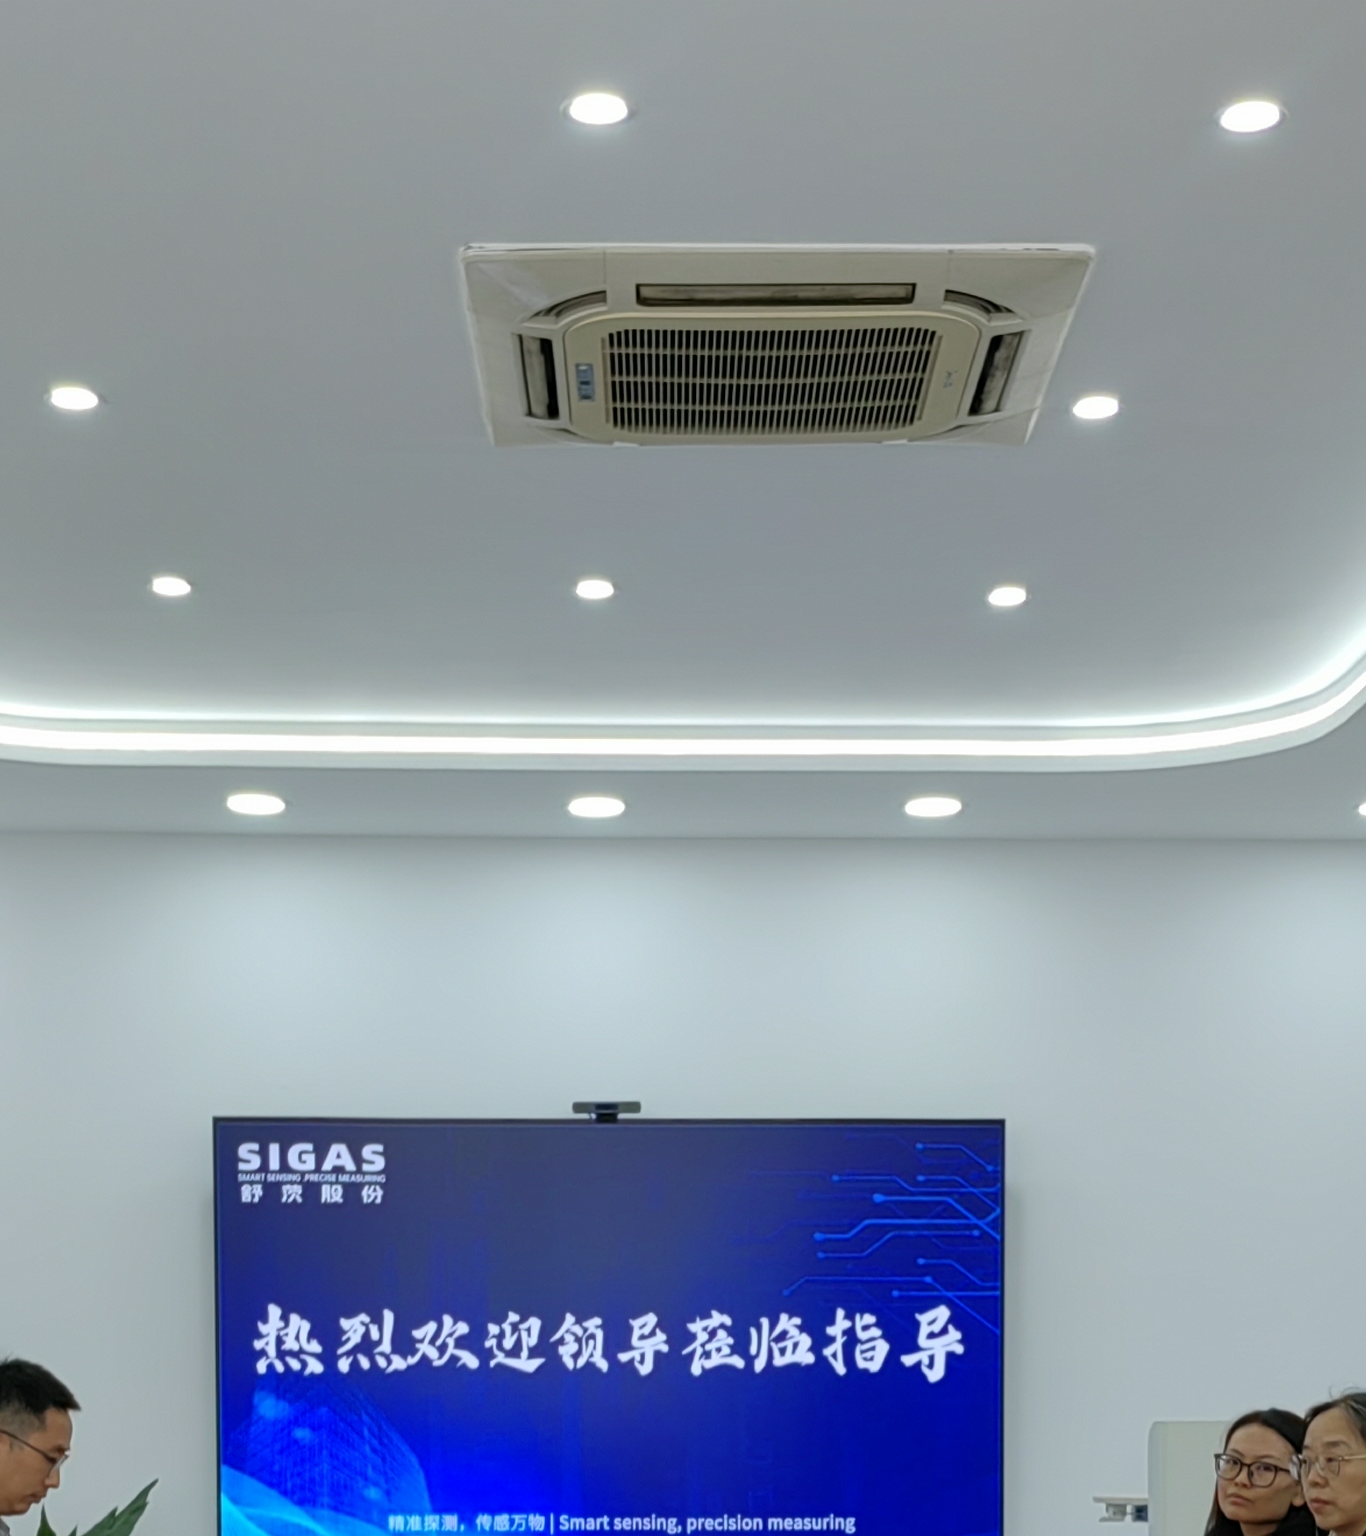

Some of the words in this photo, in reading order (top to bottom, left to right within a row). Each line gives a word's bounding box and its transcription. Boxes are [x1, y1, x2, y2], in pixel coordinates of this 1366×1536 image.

[237, 1142, 386, 1172] SIGAS
[237, 1173, 265, 1183] SMART
[267, 1173, 301, 1183] SENSING
[338, 1174, 386, 1184] MEASURING
[252, 1303, 966, 1383] 热烈欢迎领导莅临指导
[559, 1514, 610, 1531] Smart
[613, 1513, 682, 1534] sensing,
[687, 1513, 763, 1534] precision
[767, 1513, 856, 1534] measuring
